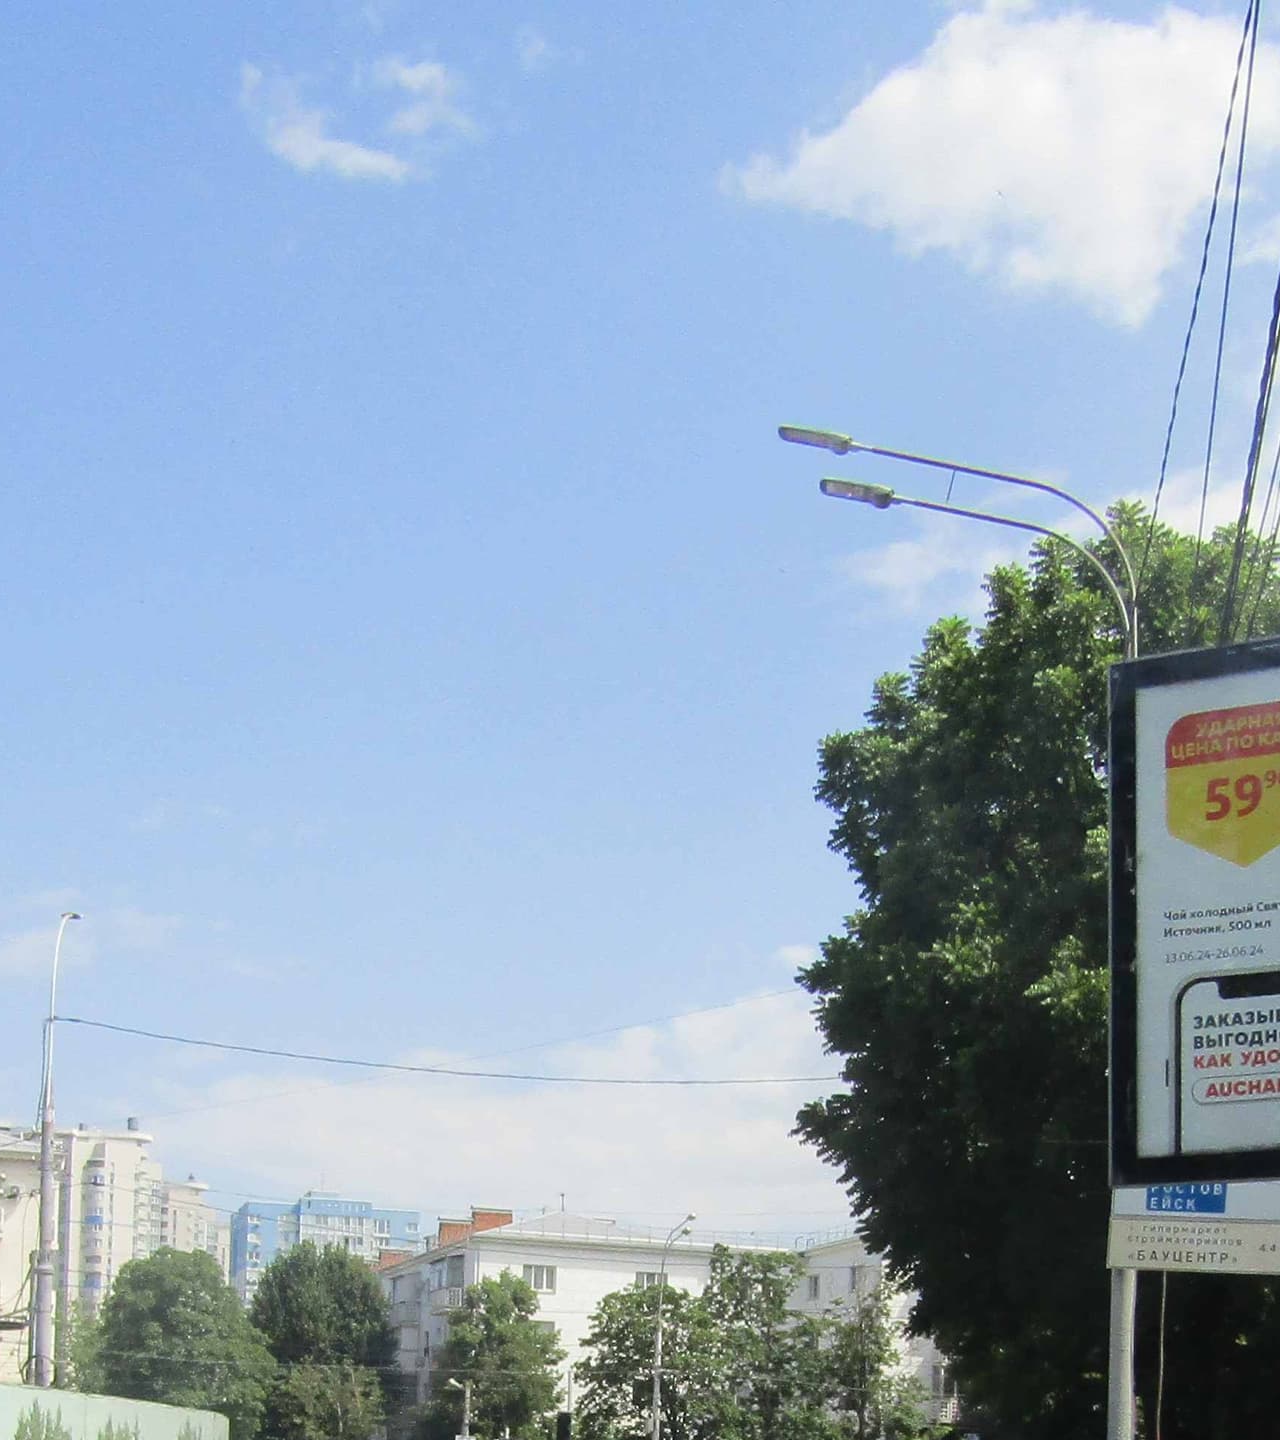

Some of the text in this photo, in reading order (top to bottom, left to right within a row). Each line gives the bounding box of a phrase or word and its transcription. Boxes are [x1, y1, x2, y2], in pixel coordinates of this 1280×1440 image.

[1171, 739, 1222, 762] ЦЕНА
[1226, 735, 1254, 752] ПО
[1205, 774, 1263, 822] 59
[1190, 904, 1254, 919] холодный
[1228, 920, 1253, 932] 500
[1254, 919, 1272, 929] мл
[1193, 1052, 1233, 1069] КАК
[1150, 1196, 1196, 1210] ЕЙСК
[1142, 1225, 1227, 1235] гипермаркет
[1127, 1235, 1243, 1247] стройматериалов
